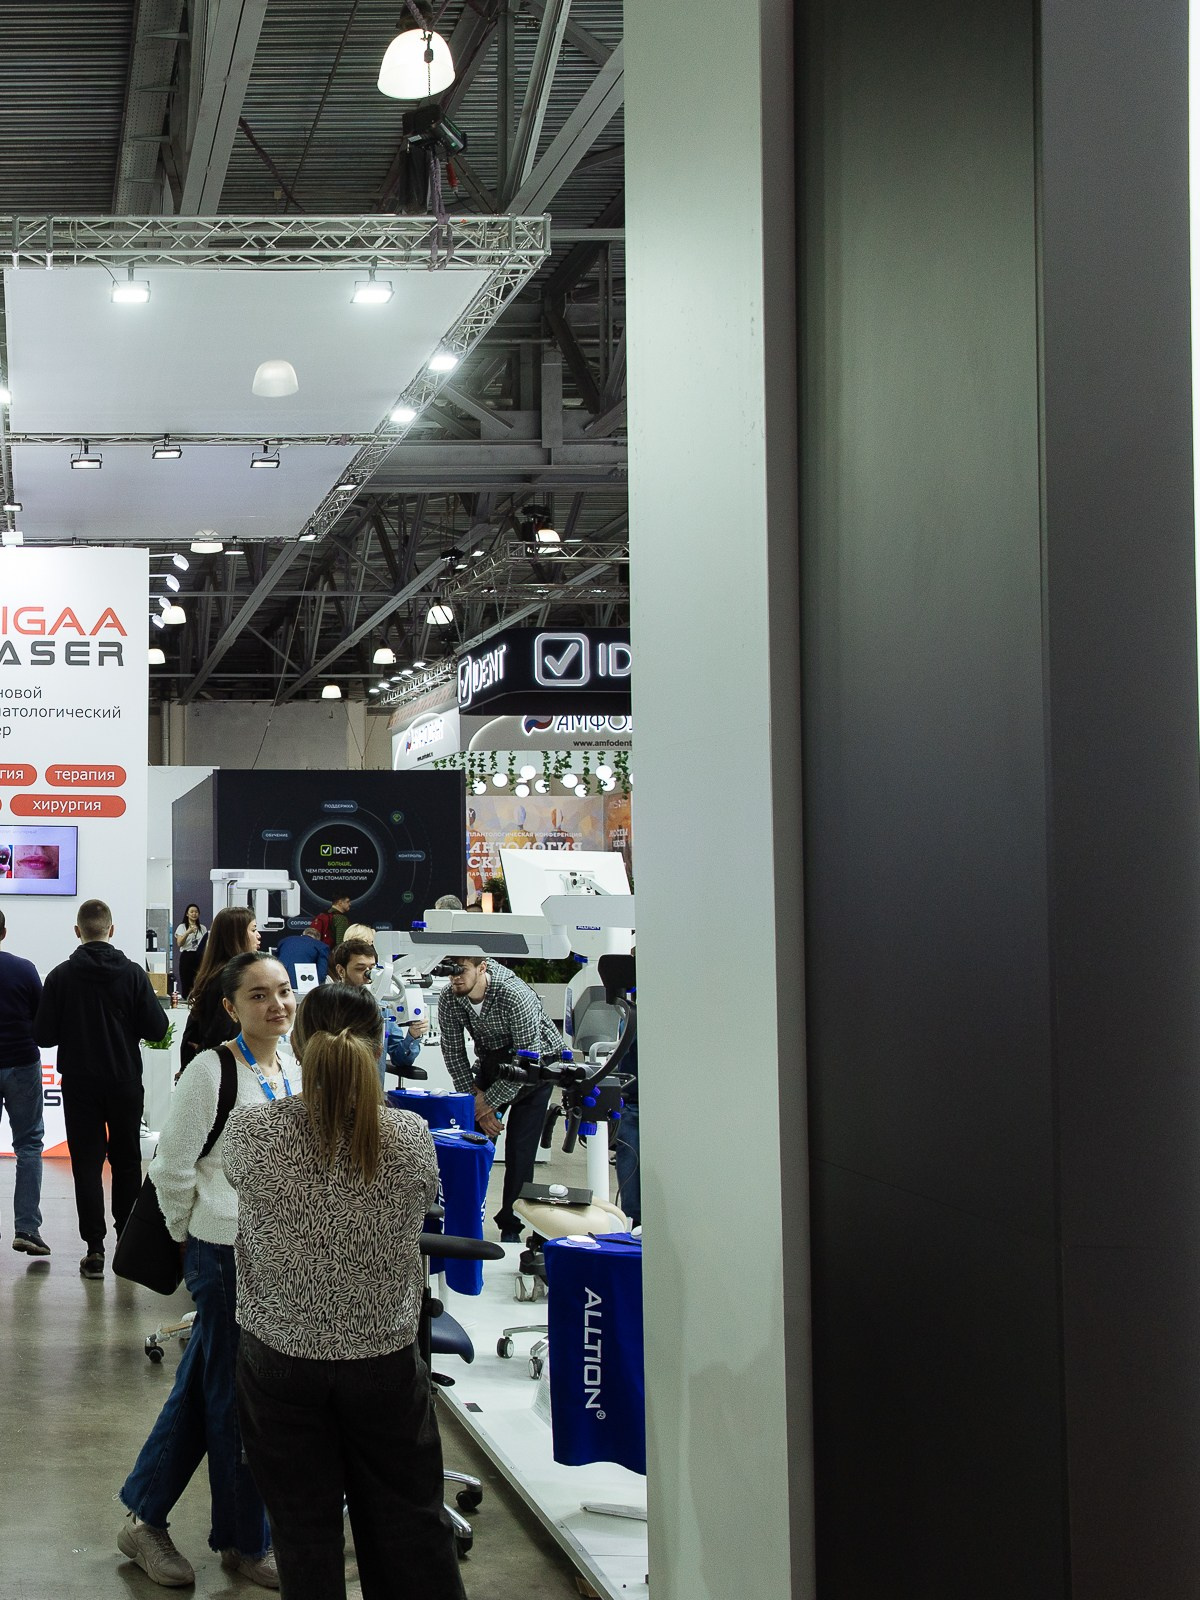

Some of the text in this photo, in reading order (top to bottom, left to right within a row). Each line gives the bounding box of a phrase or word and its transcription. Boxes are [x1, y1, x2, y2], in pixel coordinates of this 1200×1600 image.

[472, 644, 507, 693] IDENT
[556, 715, 632, 732] АМФО
[54, 768, 115, 781] терапия
[32, 799, 102, 812] хирургия
[333, 846, 358, 855] IDENT
